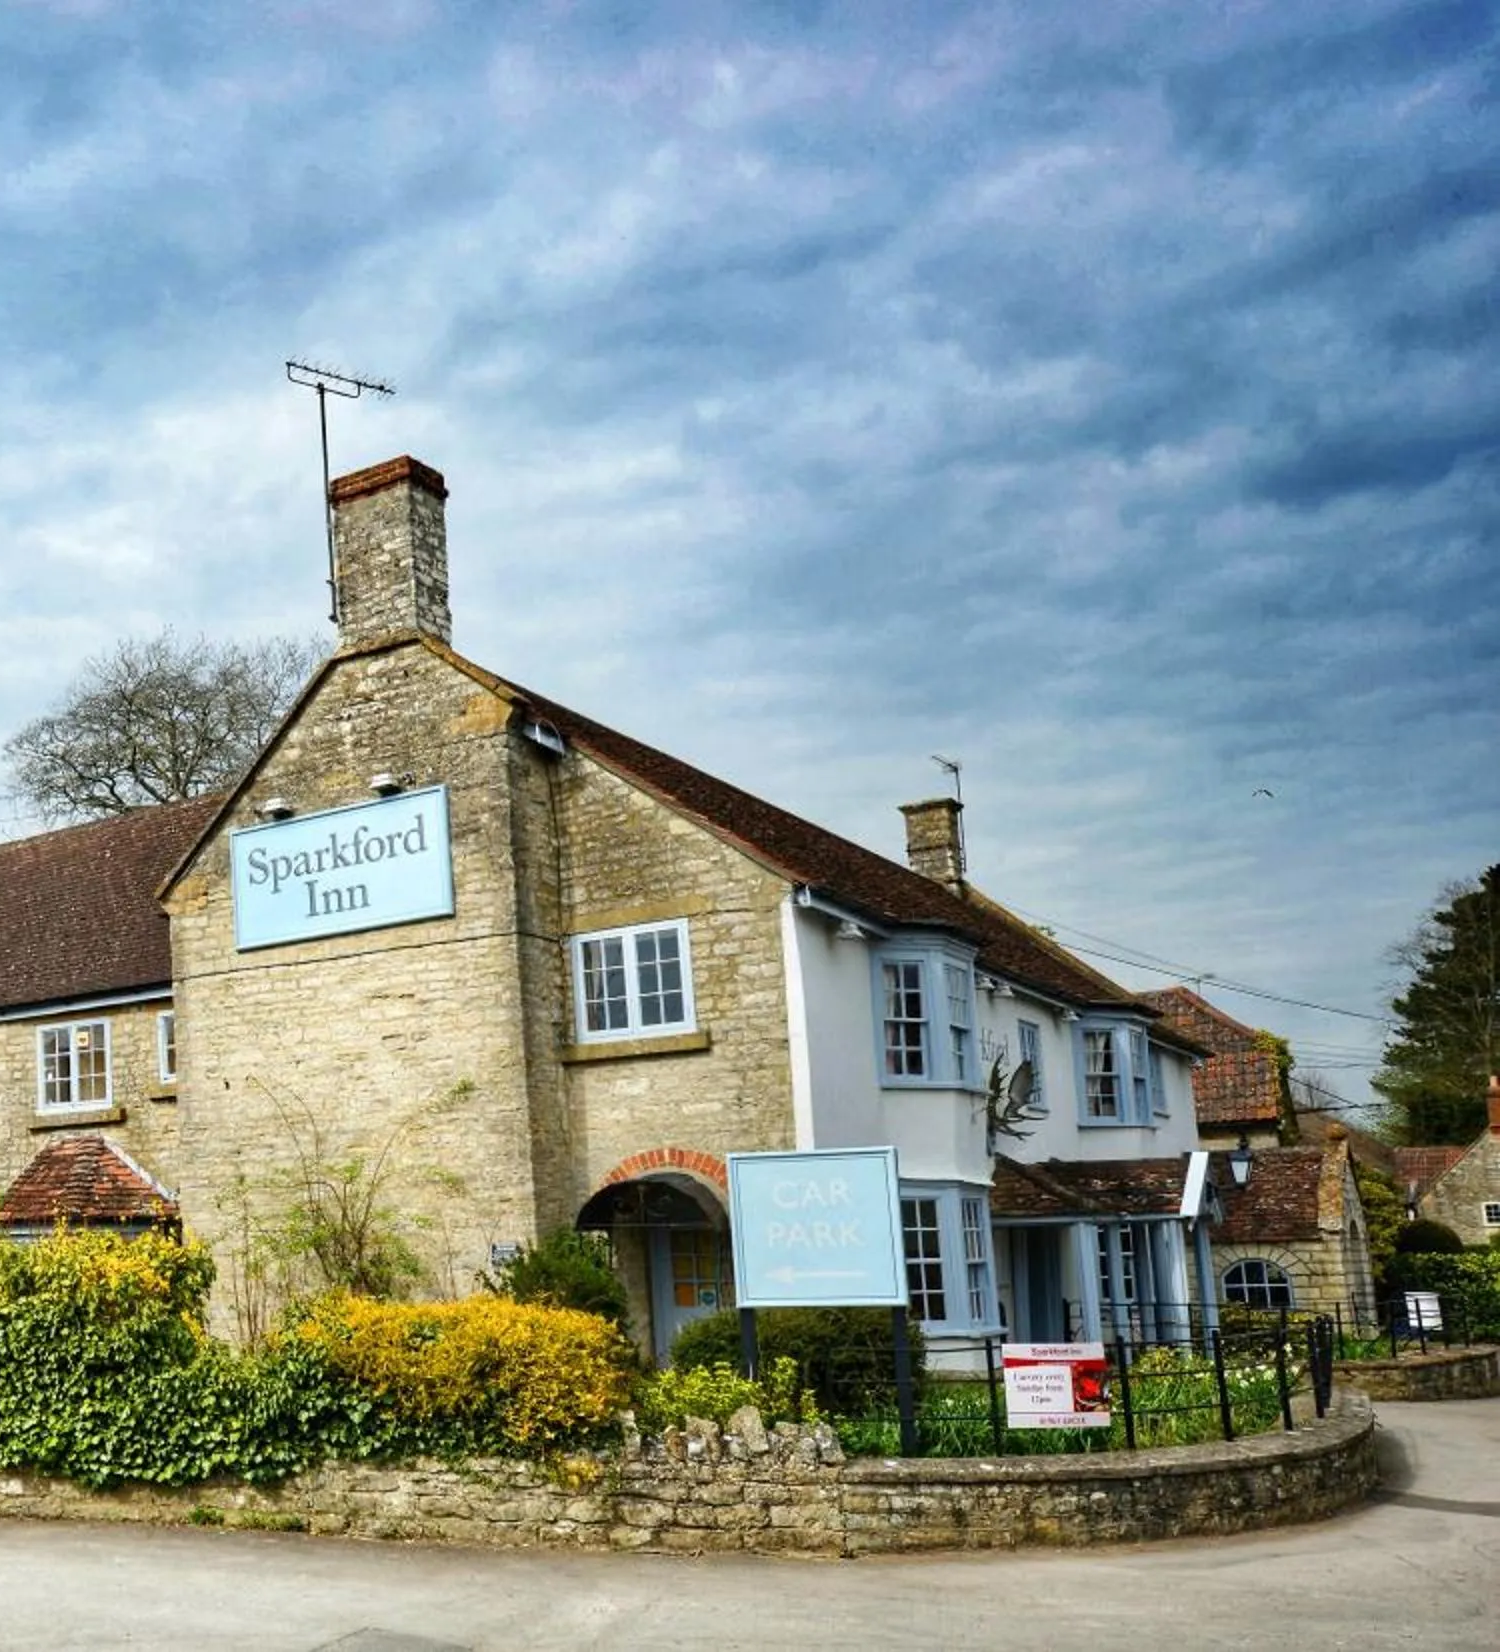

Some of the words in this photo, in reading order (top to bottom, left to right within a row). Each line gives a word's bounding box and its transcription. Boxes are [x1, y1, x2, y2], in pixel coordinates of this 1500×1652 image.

[247, 813, 428, 894] Sparkford
[304, 879, 371, 918] Inn
[772, 1177, 853, 1209] CAR
[767, 1218, 867, 1249] PARK
